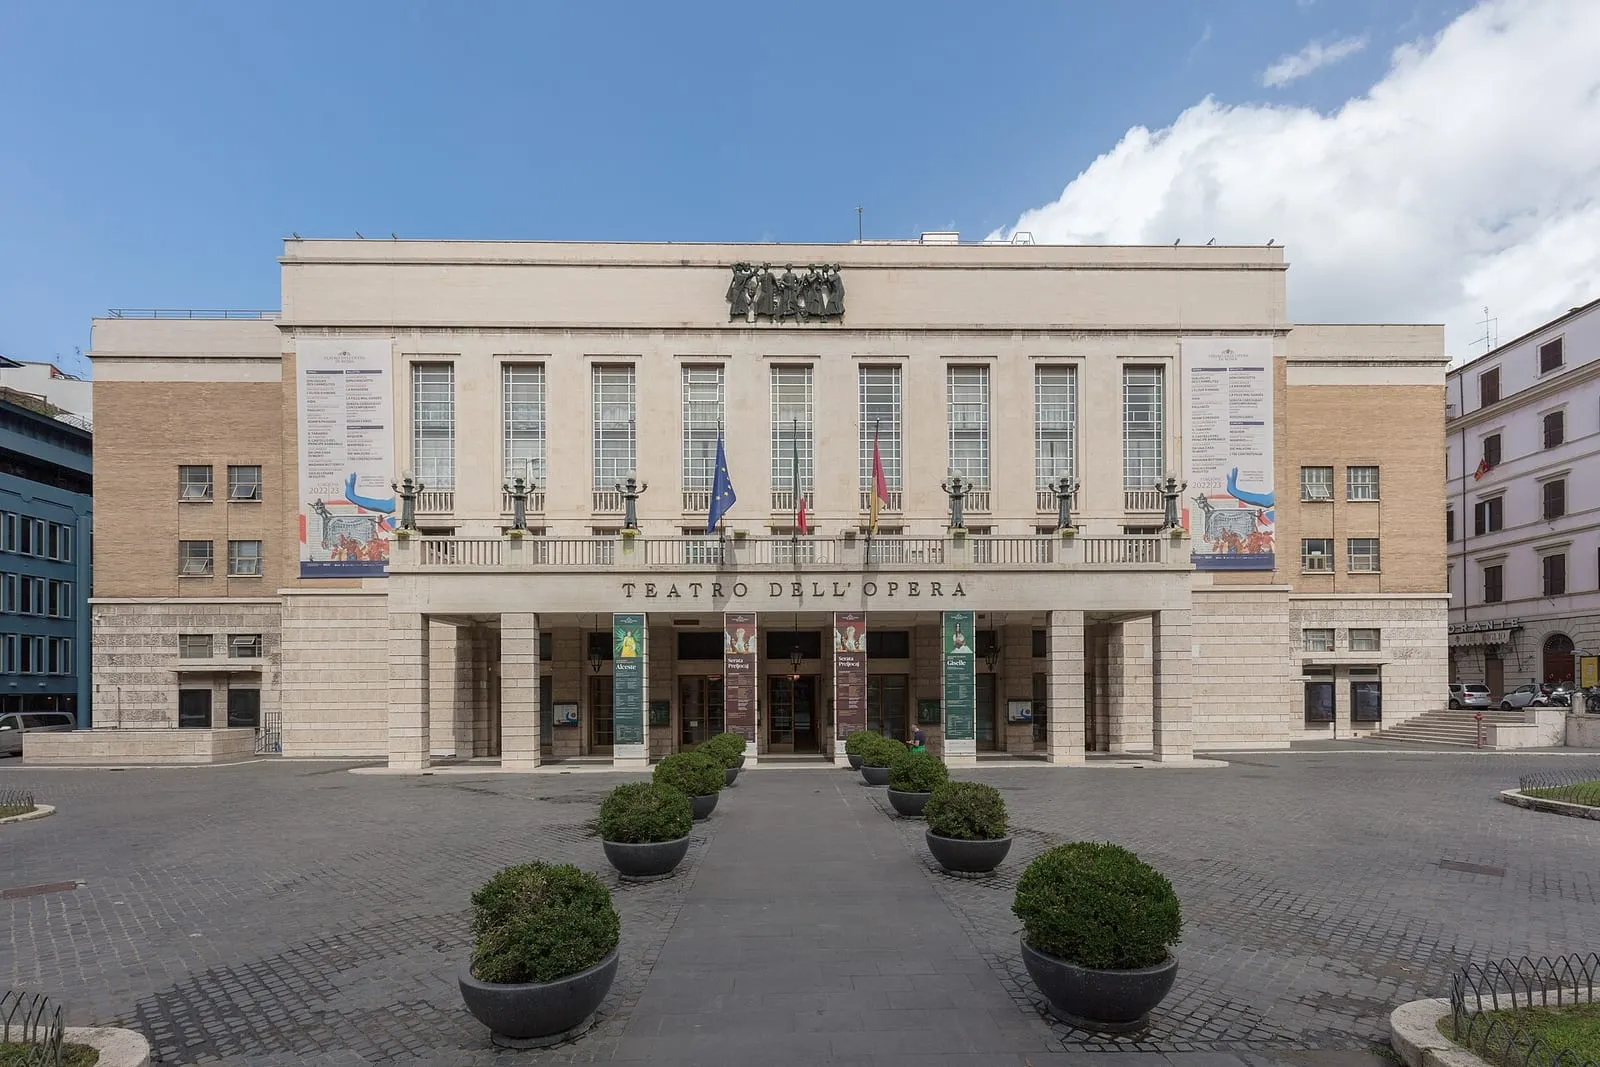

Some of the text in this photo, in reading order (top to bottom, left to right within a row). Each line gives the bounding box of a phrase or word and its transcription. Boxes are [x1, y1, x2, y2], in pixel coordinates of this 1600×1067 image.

[309, 487, 328, 495] 2022
[622, 582, 967, 598] TEATRO DELL'OPERA
